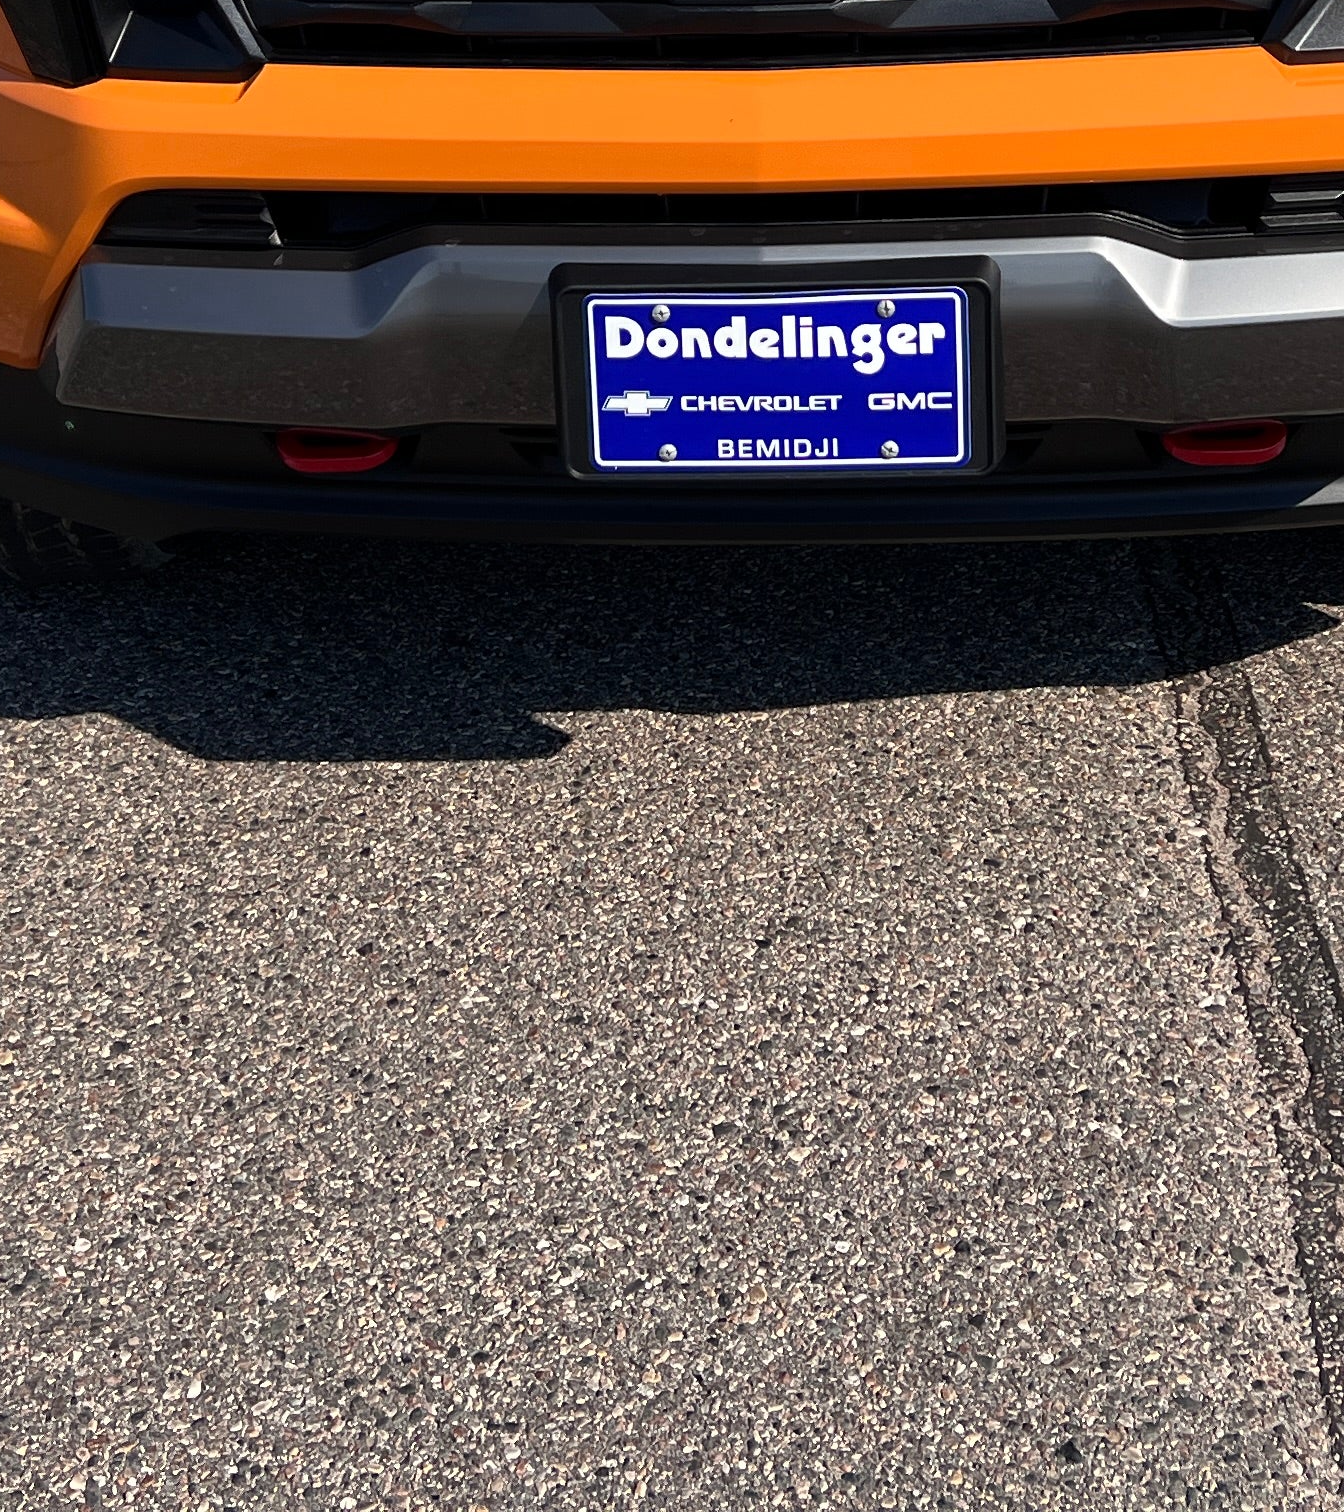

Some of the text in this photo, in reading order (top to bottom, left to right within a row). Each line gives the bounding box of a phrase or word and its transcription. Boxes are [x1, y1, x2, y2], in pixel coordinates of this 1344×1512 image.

[604, 314, 946, 375] Dondelinger
[680, 391, 953, 412] CHEVROLET GMC
[717, 437, 839, 459] BEMIDJI
